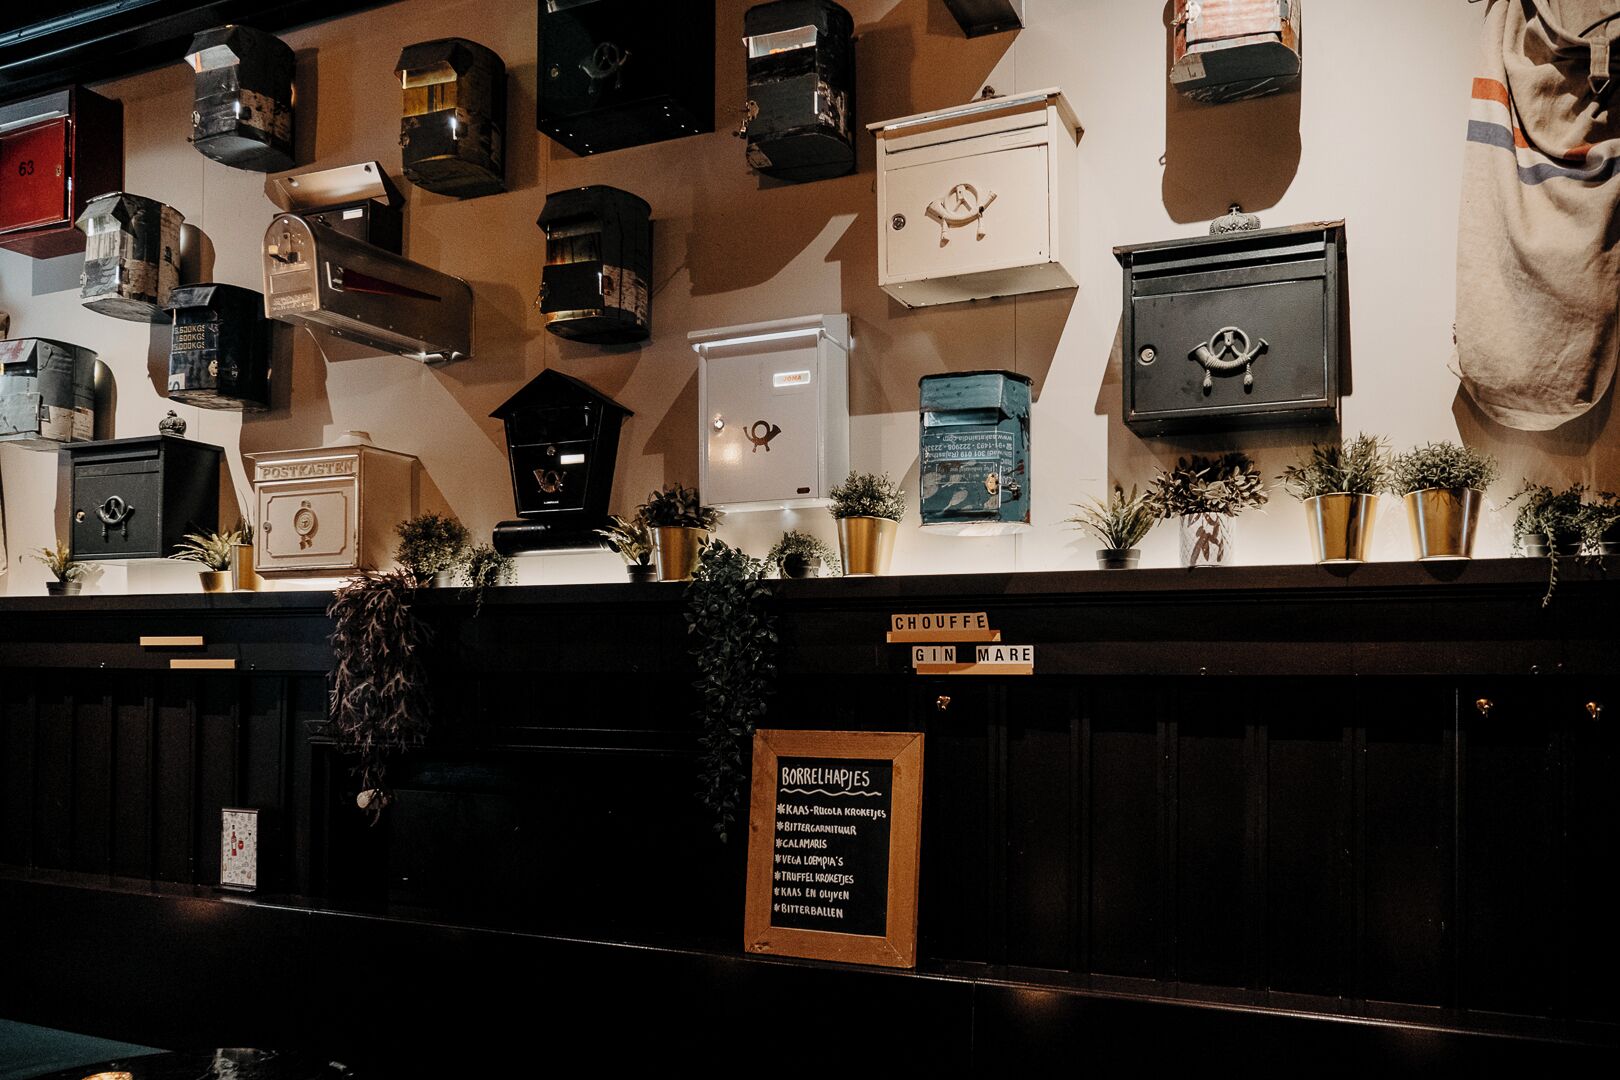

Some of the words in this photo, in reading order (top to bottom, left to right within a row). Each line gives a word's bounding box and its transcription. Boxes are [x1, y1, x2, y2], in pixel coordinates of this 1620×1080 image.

[19, 160, 34, 176] 63
[263, 461, 353, 479] POSTKASTEN
[895, 615, 986, 630] CHOUFFE
[916, 648, 953, 661] GIN
[978, 648, 1031, 661] MARE
[782, 767, 870, 791] BORRELHAPJES
[844, 808, 886, 820] KROKETJES
[784, 822, 857, 835] BITTERGARNITUUR
[782, 839, 827, 848] CALAMARIS
[782, 855, 801, 865] VEGA
[803, 856, 844, 870] LOEMPIA'S
[781, 871, 814, 882] TRUFFEL
[815, 873, 854, 885] KROKETJES
[781, 887, 801, 897] KAAS
[805, 888, 816, 897] EN
[819, 890, 849, 903] OLIJVEN
[781, 903, 843, 918] BITTERBALLEN
